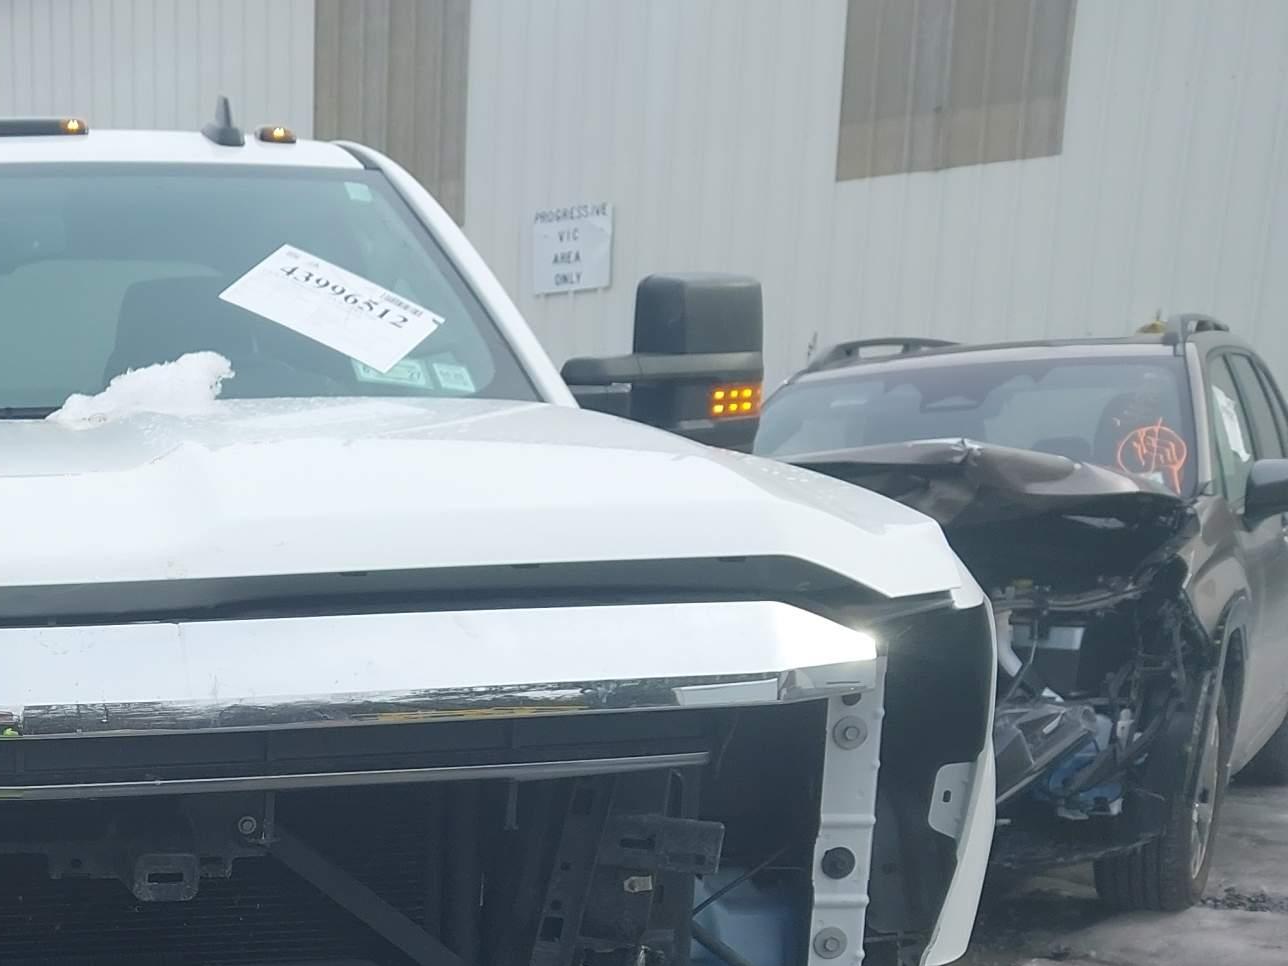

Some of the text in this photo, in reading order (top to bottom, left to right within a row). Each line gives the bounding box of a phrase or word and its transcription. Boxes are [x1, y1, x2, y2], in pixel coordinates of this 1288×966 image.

[534, 202, 609, 224] PROGRESSIVE
[558, 227, 580, 242] VIC
[552, 250, 581, 264] AREA
[554, 272, 582, 286] ONLY
[279, 265, 409, 329] 43996512
